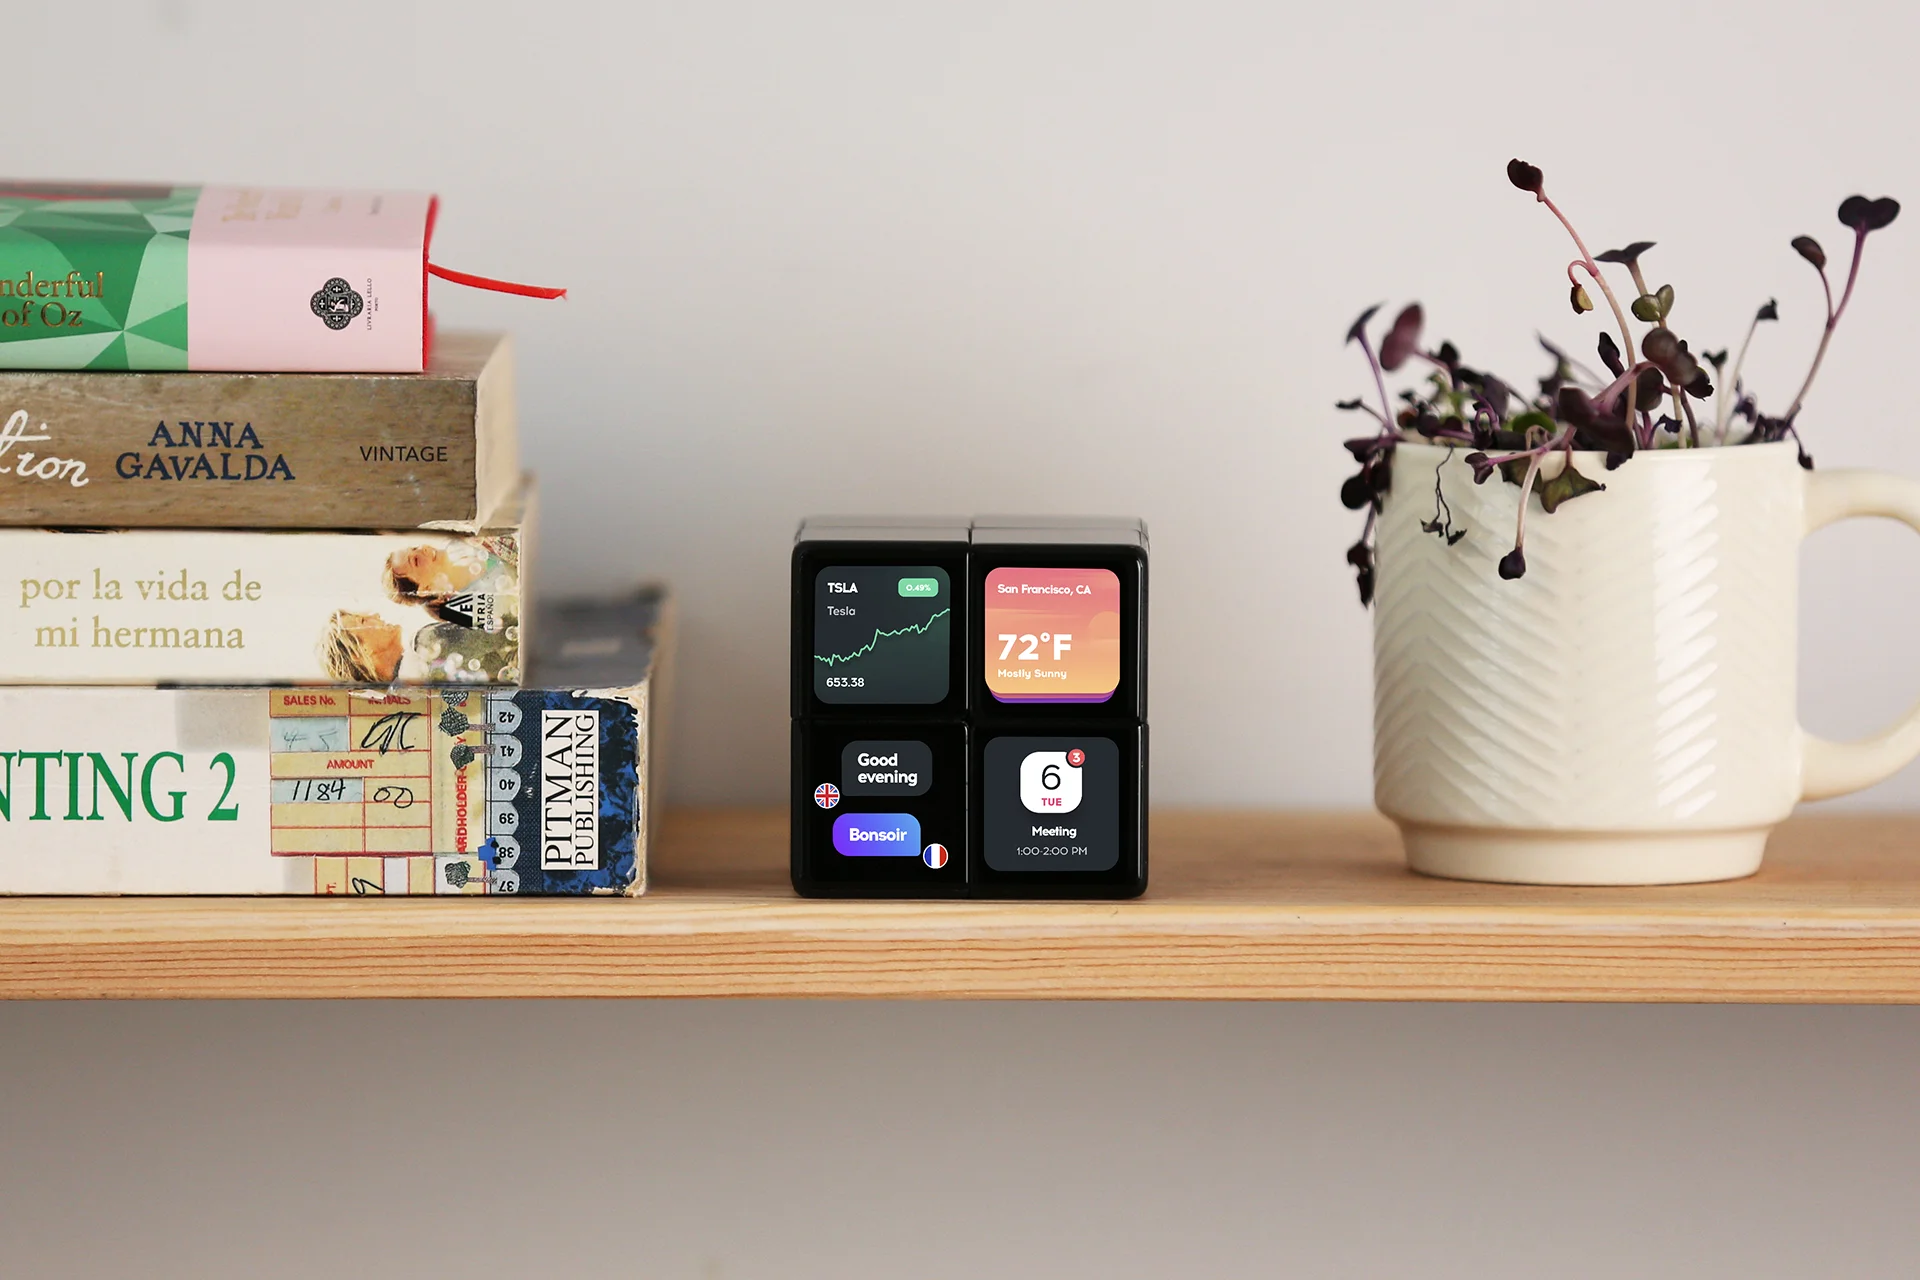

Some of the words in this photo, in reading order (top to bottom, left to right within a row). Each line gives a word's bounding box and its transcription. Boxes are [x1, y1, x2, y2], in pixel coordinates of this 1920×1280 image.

[0, 271, 104, 298] nderful
[2, 300, 36, 327] of
[41, 302, 83, 328] Oz
[148, 421, 263, 449] ANNA
[360, 445, 449, 463] VINTAGE
[116, 452, 296, 482] GAVALDA
[20, 571, 81, 608] por
[92, 568, 122, 601] la
[135, 568, 209, 601] vida
[220, 568, 262, 601] de
[827, 582, 858, 593] TSLA
[905, 584, 932, 592] 0.49%
[998, 584, 1018, 594] San
[1021, 584, 1073, 596] Francisco,
[1076, 585, 1092, 595] CA
[477, 594, 485, 630] ATRIA
[827, 605, 856, 616] Tesla
[35, 617, 79, 648] mi
[92, 615, 245, 648] hermana
[998, 632, 1072, 661] 72°F
[998, 669, 1030, 680] Mostly
[1034, 669, 1067, 680] Sunny
[826, 677, 865, 688] 653.38
[284, 695, 317, 706] SALES
[320, 695, 336, 706] No.
[499, 711, 515, 723] 42
[500, 745, 514, 757] 41
[327, 760, 375, 769] AMOUNT
[858, 753, 898, 767] Good
[1073, 753, 1081, 763] 3
[858, 769, 918, 787] evening
[1041, 764, 1062, 791] 6
[207, 752, 239, 821] 2
[499, 779, 515, 790] 40
[545, 714, 573, 866] PITMAN
[575, 714, 594, 865] PUBLISHING
[1041, 798, 1062, 807] TUE
[499, 813, 515, 824] 39
[849, 828, 907, 842] Bonsoir
[1032, 826, 1077, 839] Meeting
[1016, 847, 1069, 856] 1:00-2:00
[1072, 847, 1088, 856] PM
